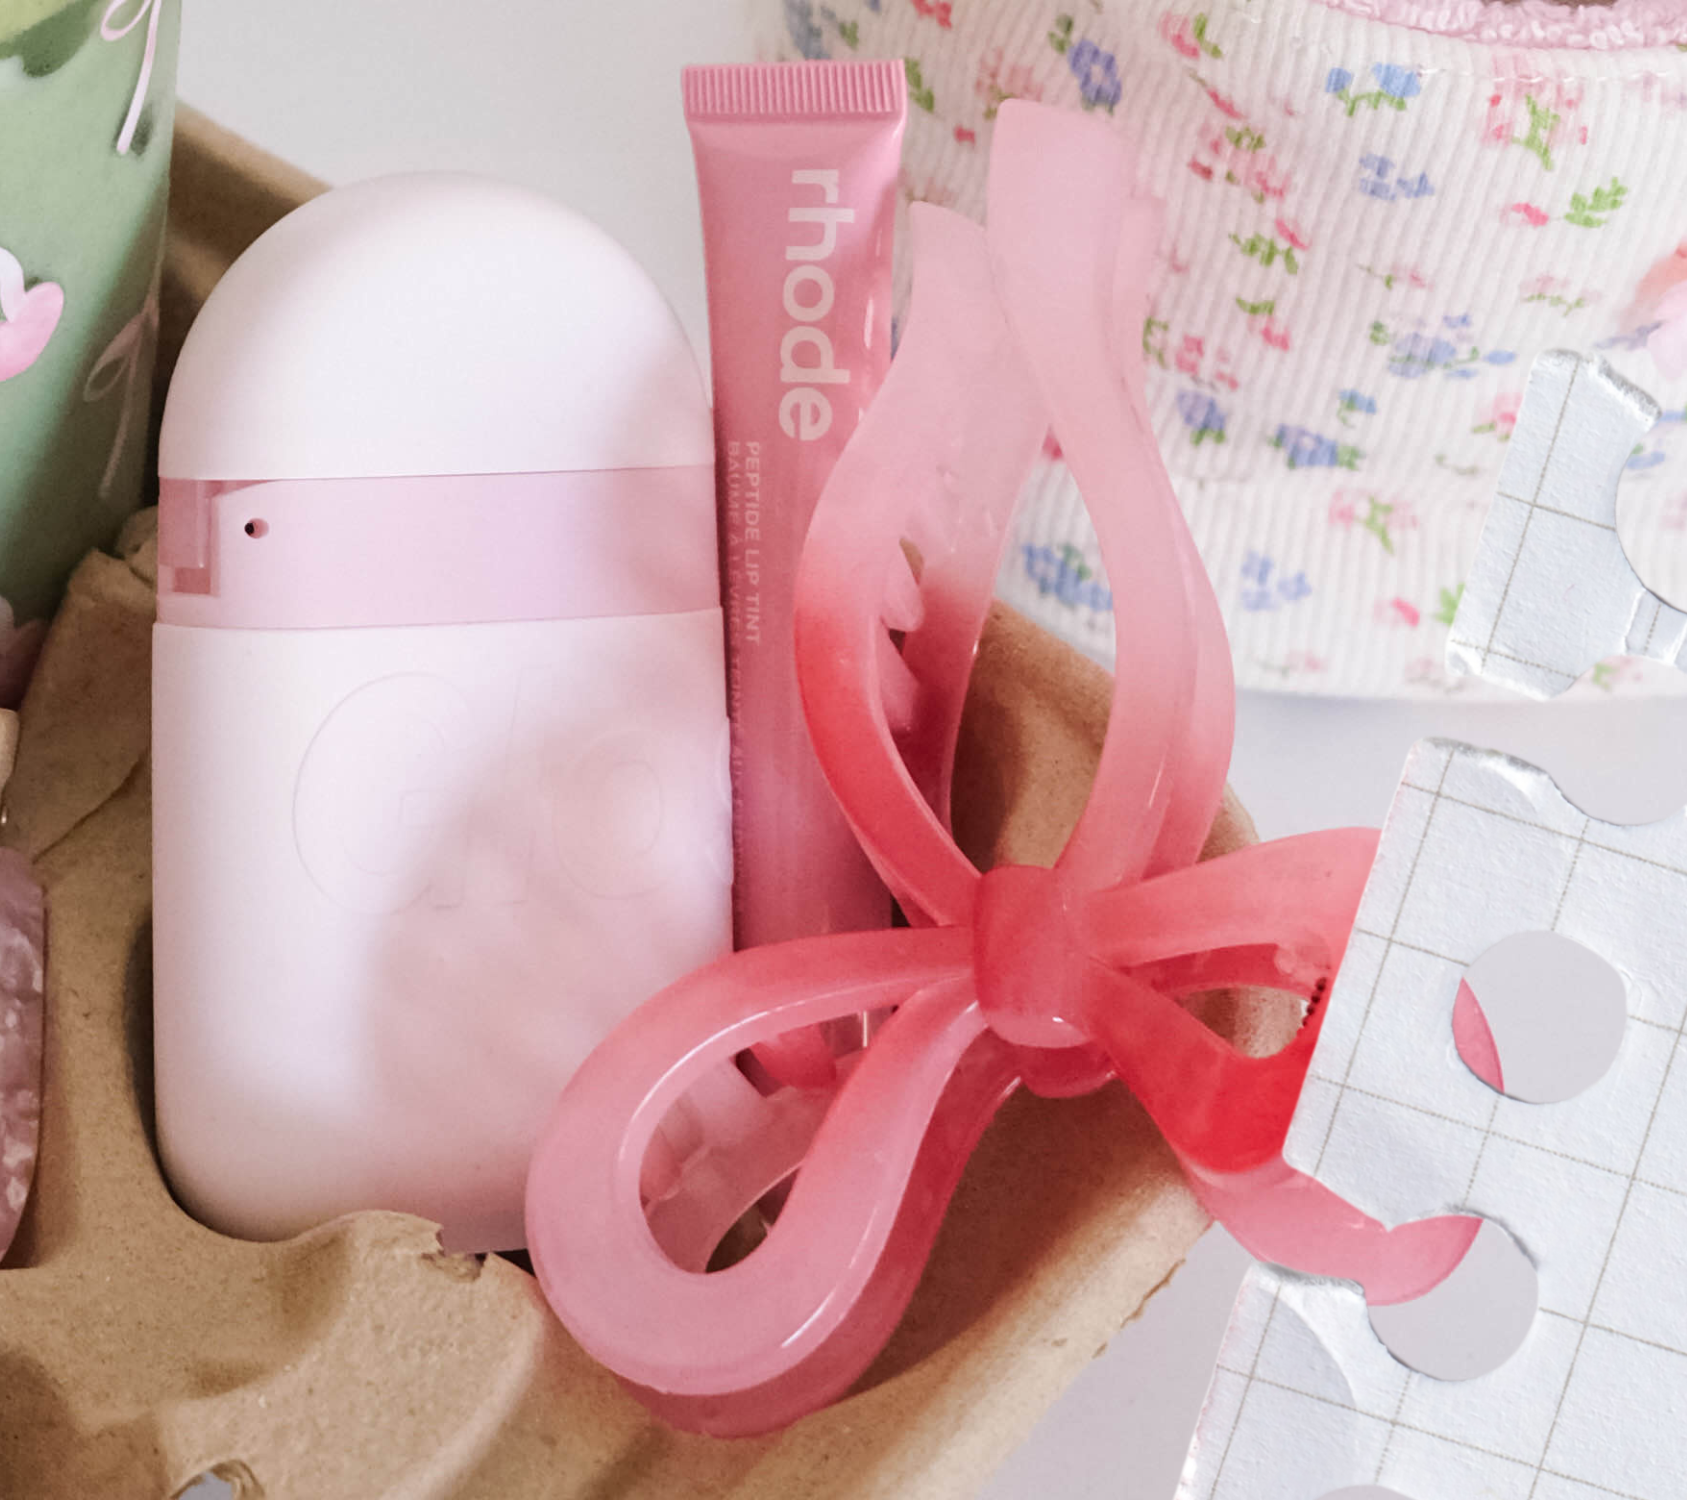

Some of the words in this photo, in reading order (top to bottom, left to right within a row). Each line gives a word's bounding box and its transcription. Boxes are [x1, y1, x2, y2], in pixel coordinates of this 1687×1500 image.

[778, 169, 855, 442] rhode
[744, 441, 760, 541] PEPTIDE
[744, 548, 760, 585] LIP
[744, 592, 760, 646] TINT
